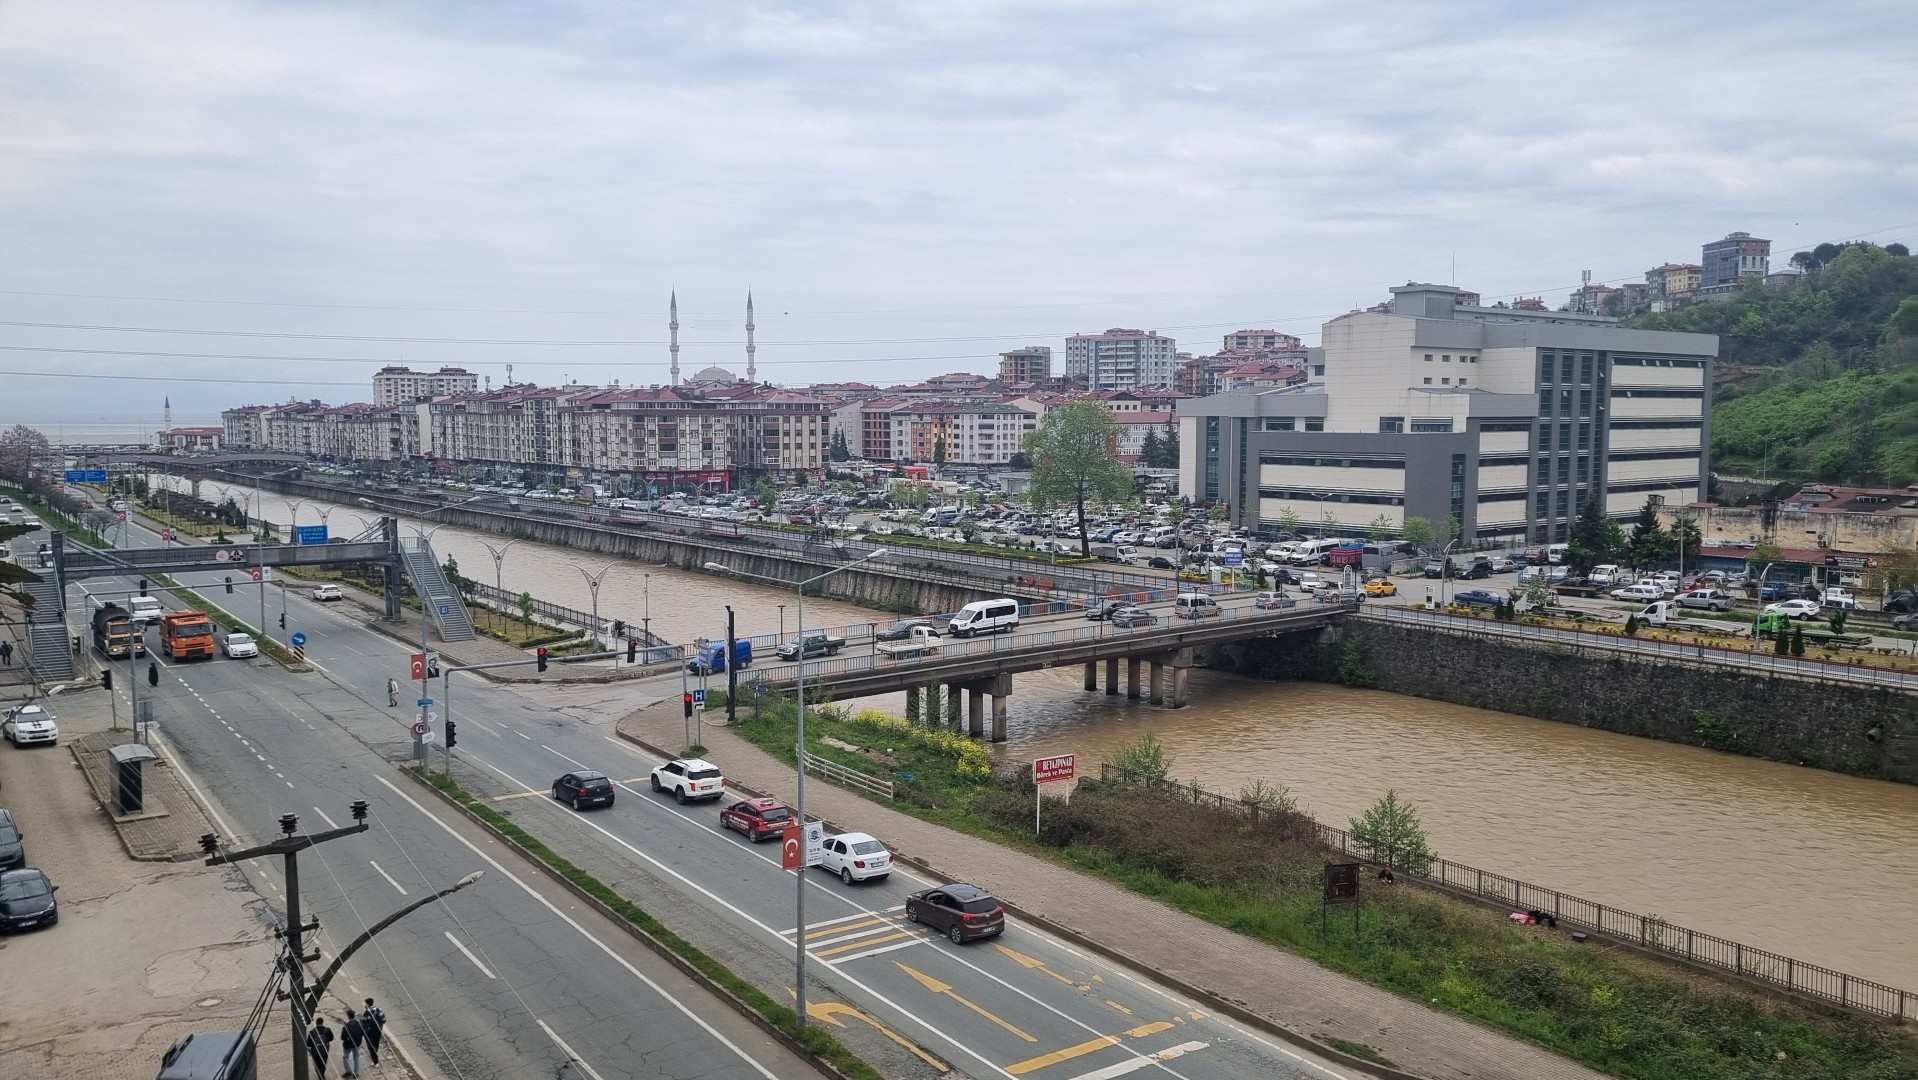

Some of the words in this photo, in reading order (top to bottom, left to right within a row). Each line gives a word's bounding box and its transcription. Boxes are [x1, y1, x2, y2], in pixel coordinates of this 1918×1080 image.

[695, 691, 703, 701] H
[1036, 771, 1052, 779] Börek
[1058, 768, 1073, 777] Pasta
